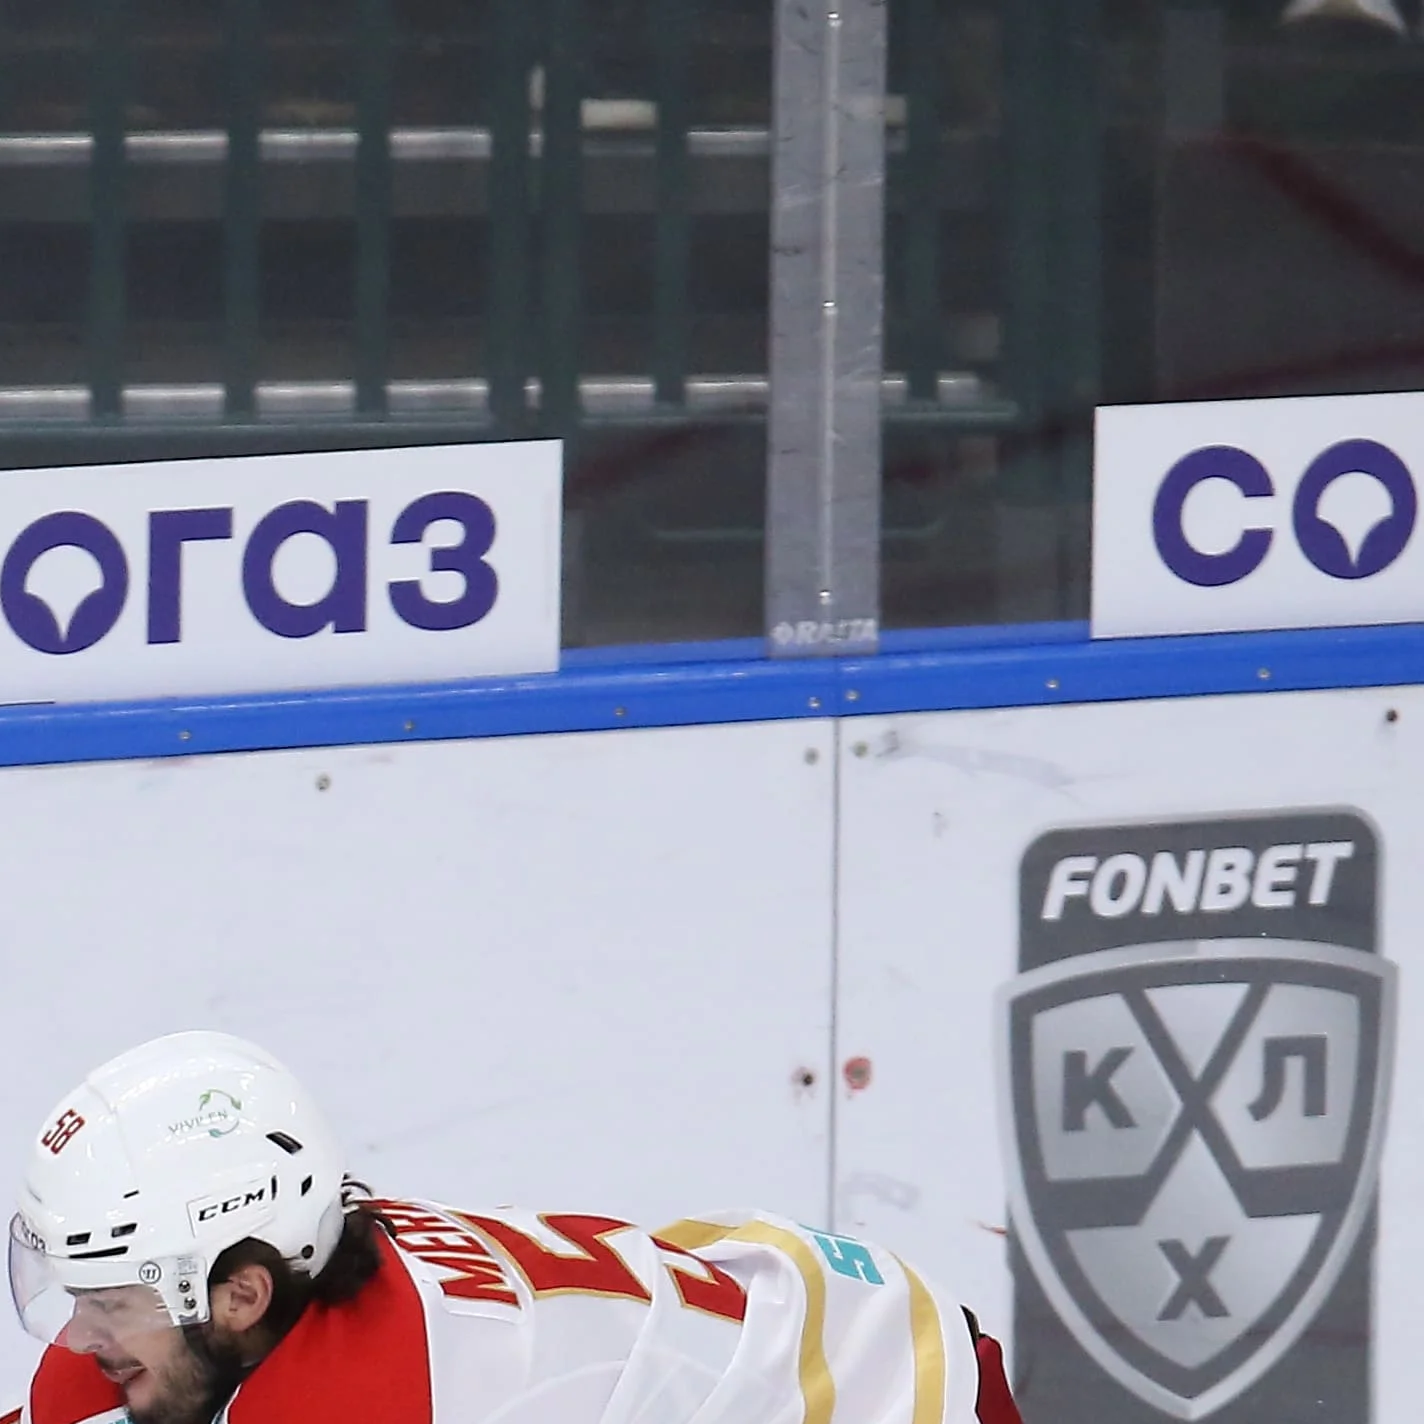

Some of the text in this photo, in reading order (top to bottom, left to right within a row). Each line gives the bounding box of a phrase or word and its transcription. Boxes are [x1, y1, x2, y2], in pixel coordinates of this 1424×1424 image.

[1041, 840, 1356, 923] FONBET
[40, 1107, 87, 1155] 58
[197, 1187, 266, 1222] CCM
